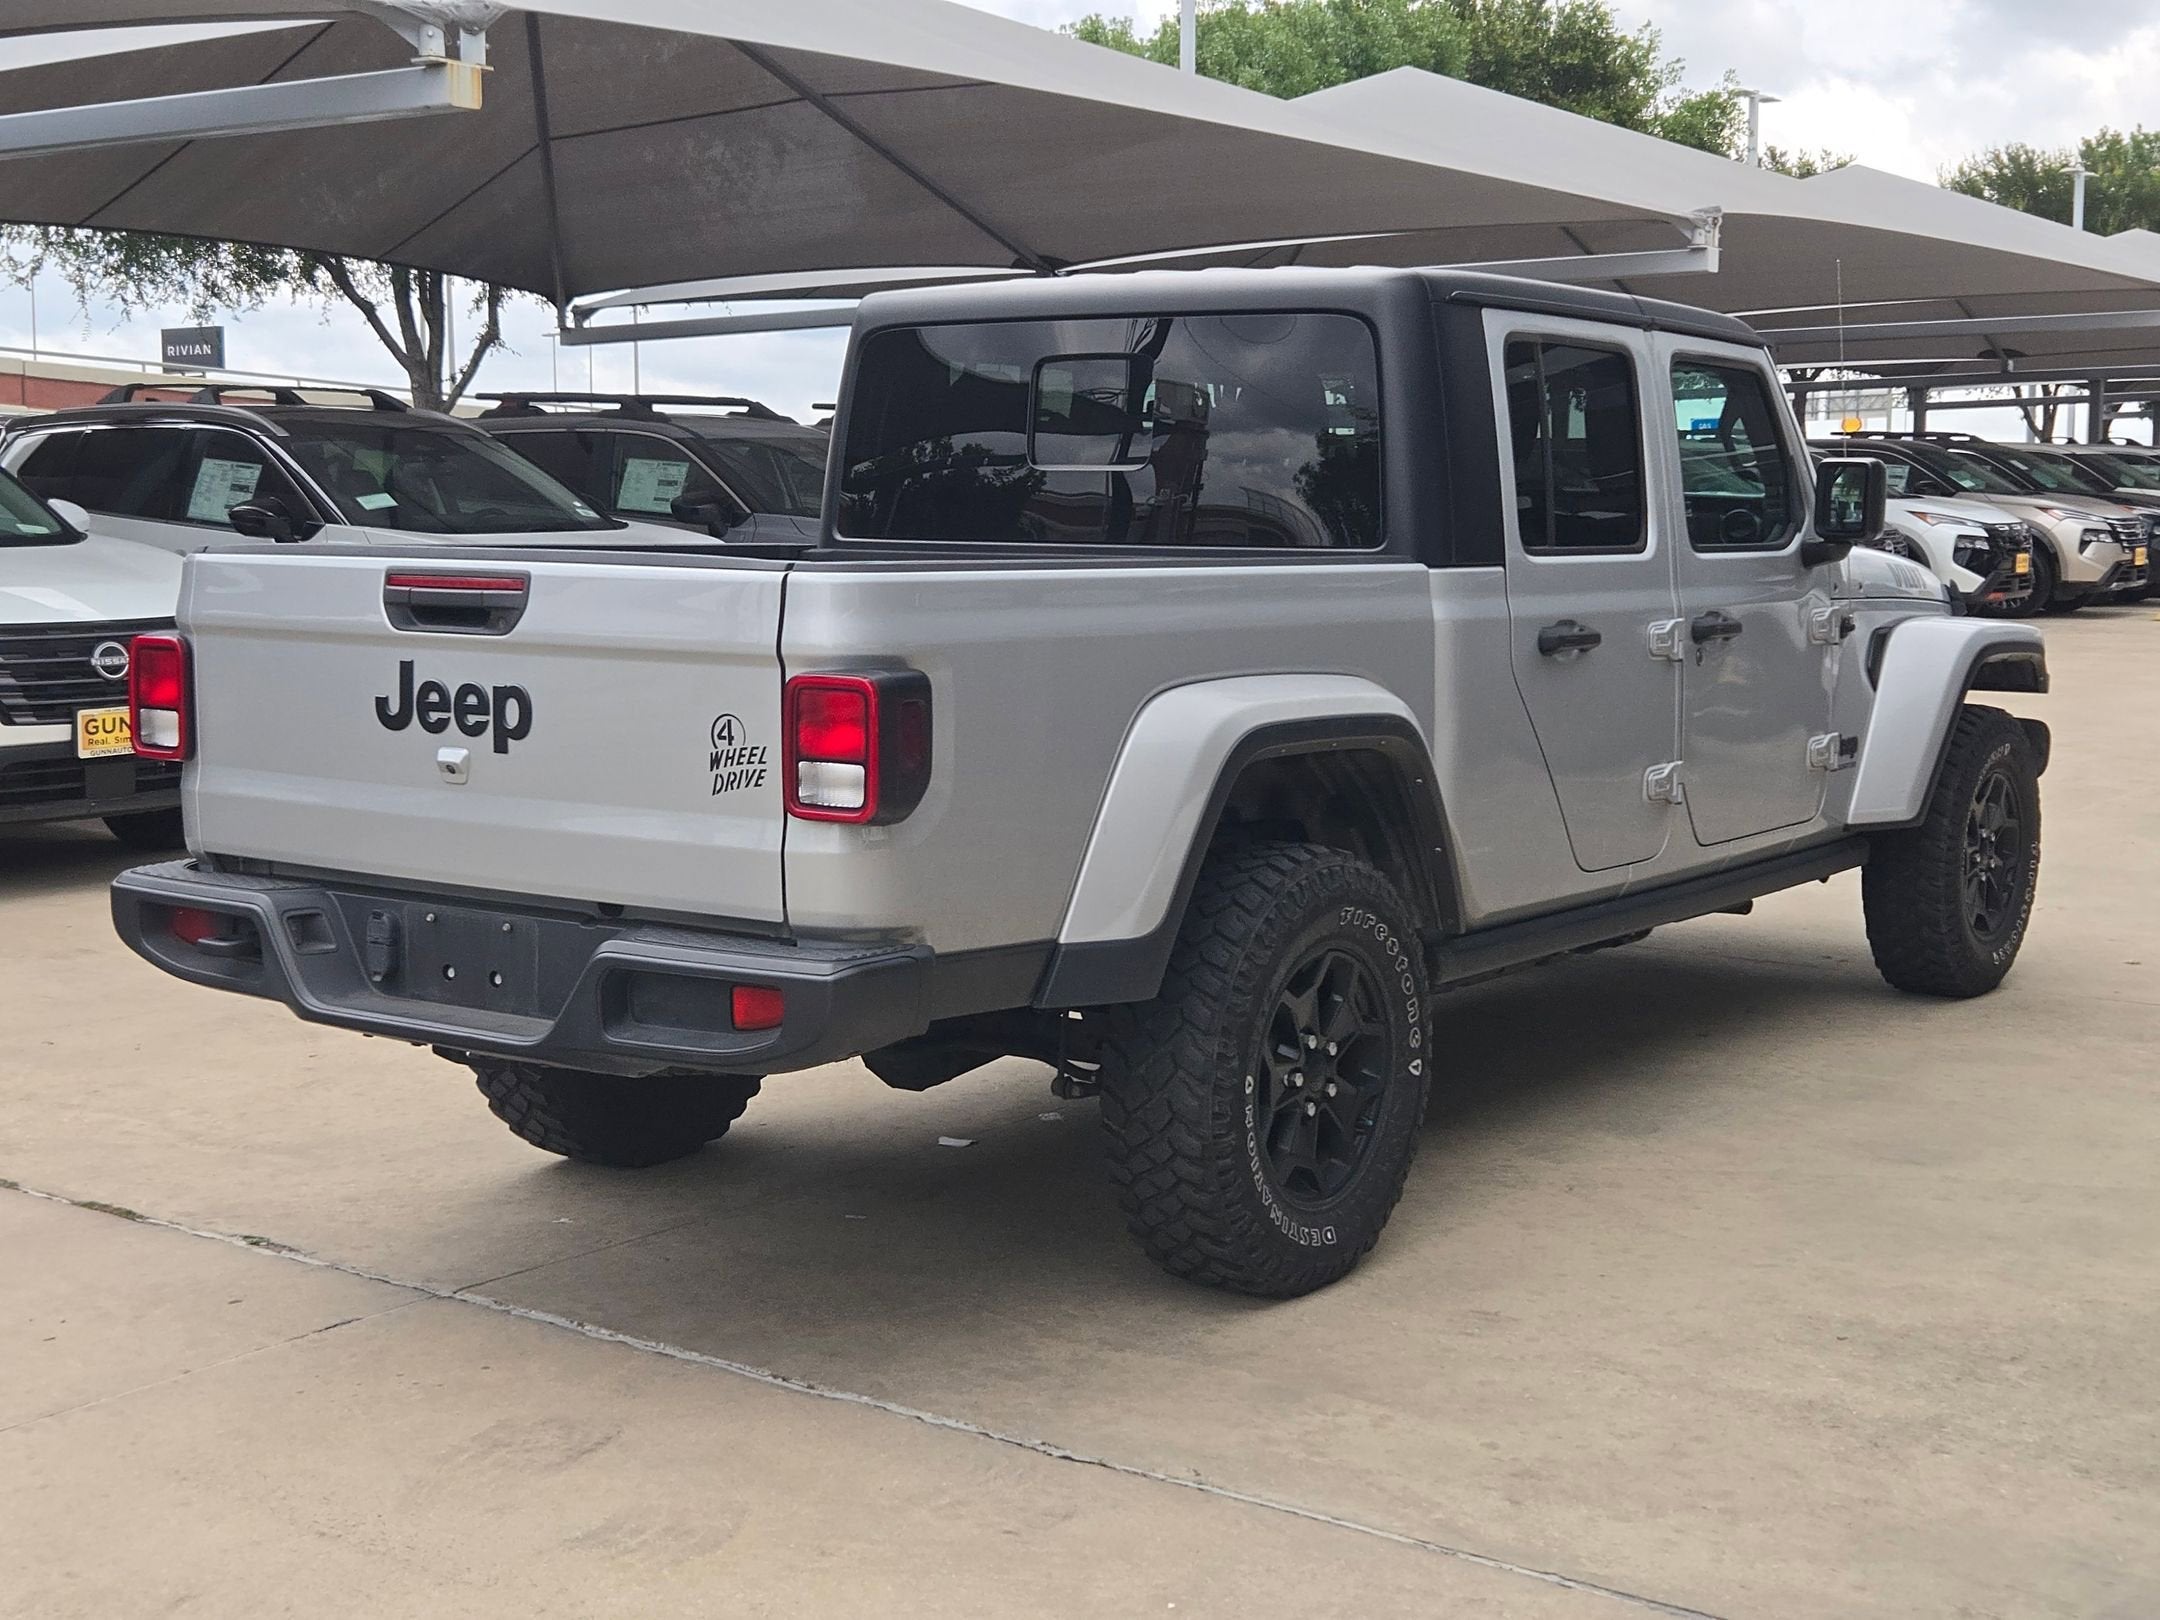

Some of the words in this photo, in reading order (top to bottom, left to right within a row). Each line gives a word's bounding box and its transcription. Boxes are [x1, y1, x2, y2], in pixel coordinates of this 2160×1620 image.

[167, 343, 211, 356] RIVIAN
[91, 656, 130, 666] NISSA
[375, 659, 533, 754] Jeep
[84, 717, 132, 735] GUN
[114, 735, 132, 744] Sim
[90, 746, 133, 756] GUNNAUTO
[709, 745, 767, 772] WHEEL
[711, 768, 767, 796] DRIVE
[1245, 1105, 1337, 1247] DESTINATION
